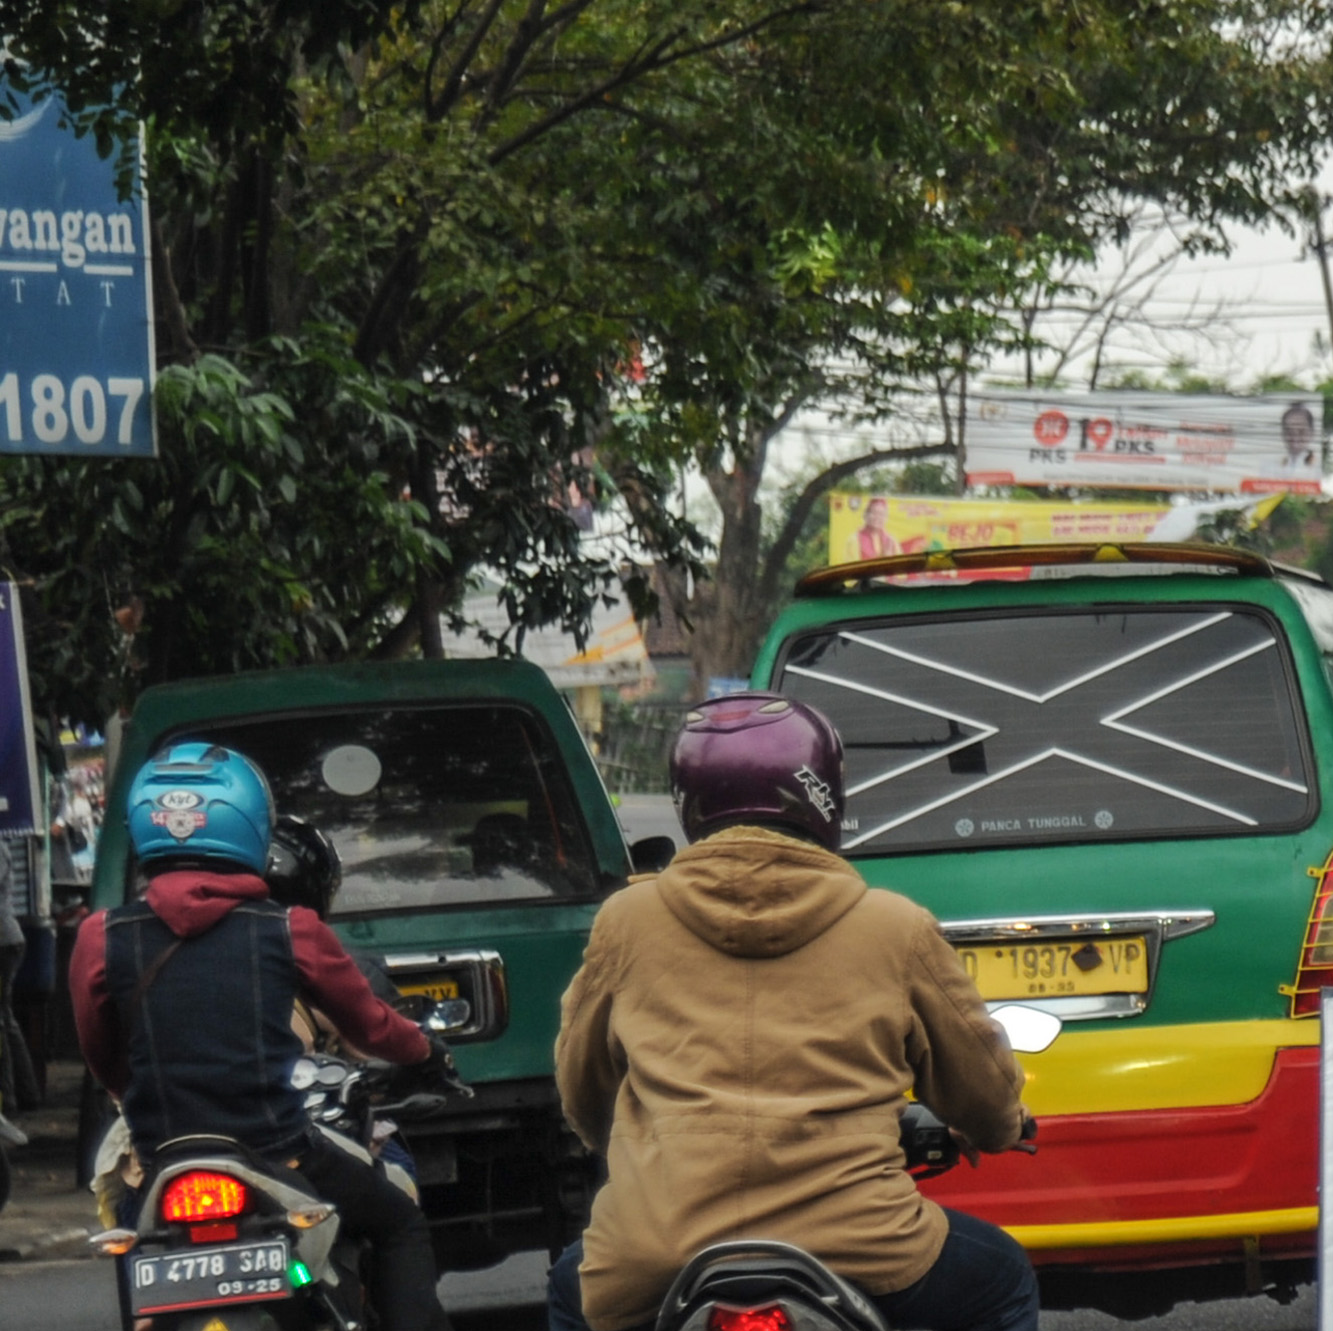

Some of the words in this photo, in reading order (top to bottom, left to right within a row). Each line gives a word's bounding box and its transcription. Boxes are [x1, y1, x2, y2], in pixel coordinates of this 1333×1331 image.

[0, 371, 144, 444] 1807
[981, 819, 1021, 832] PANCA
[1027, 815, 1087, 829] TUNGGAL
[1009, 946, 1073, 979] 1937
[1109, 943, 1139, 974] VP
[141, 1264, 154, 1286] D
[167, 1255, 224, 1283] 4778
